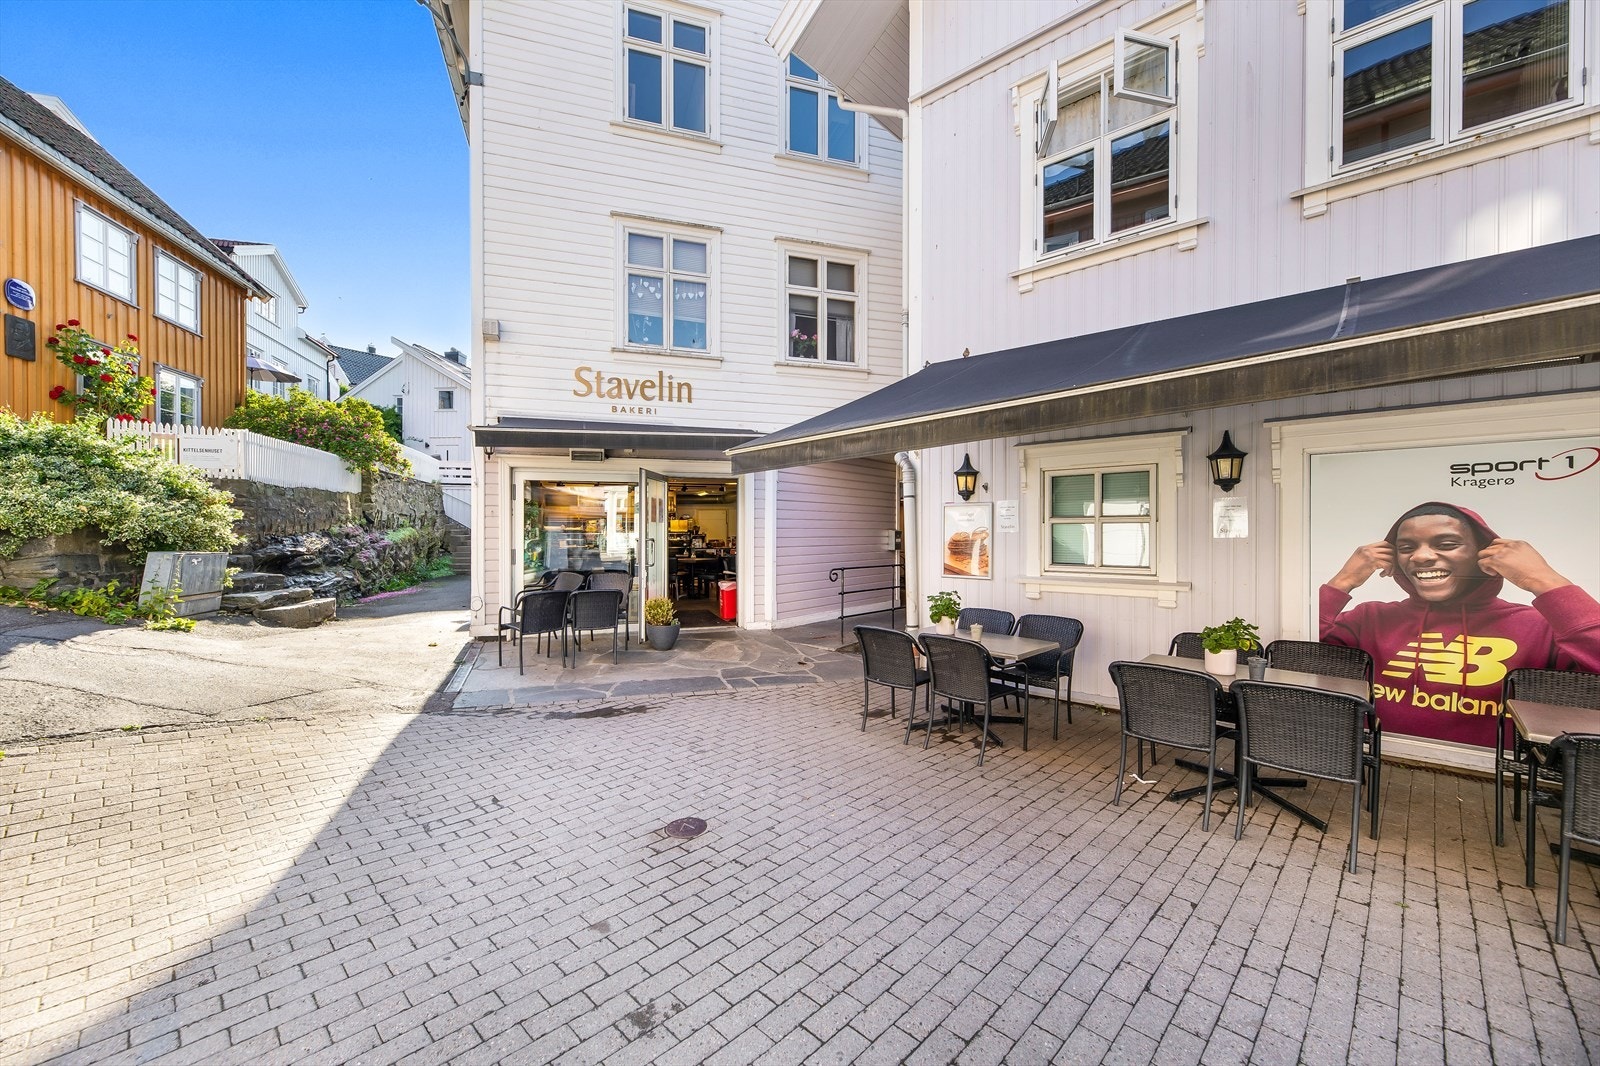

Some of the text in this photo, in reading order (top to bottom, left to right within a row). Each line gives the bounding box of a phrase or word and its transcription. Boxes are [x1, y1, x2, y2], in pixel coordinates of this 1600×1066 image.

[573, 366, 693, 403] Stavelin
[611, 405, 657, 415] BAKERI
[1450, 455, 1574, 476] sport 1
[1451, 476, 1515, 489] Kragerø
[1373, 683, 1407, 703] ew
